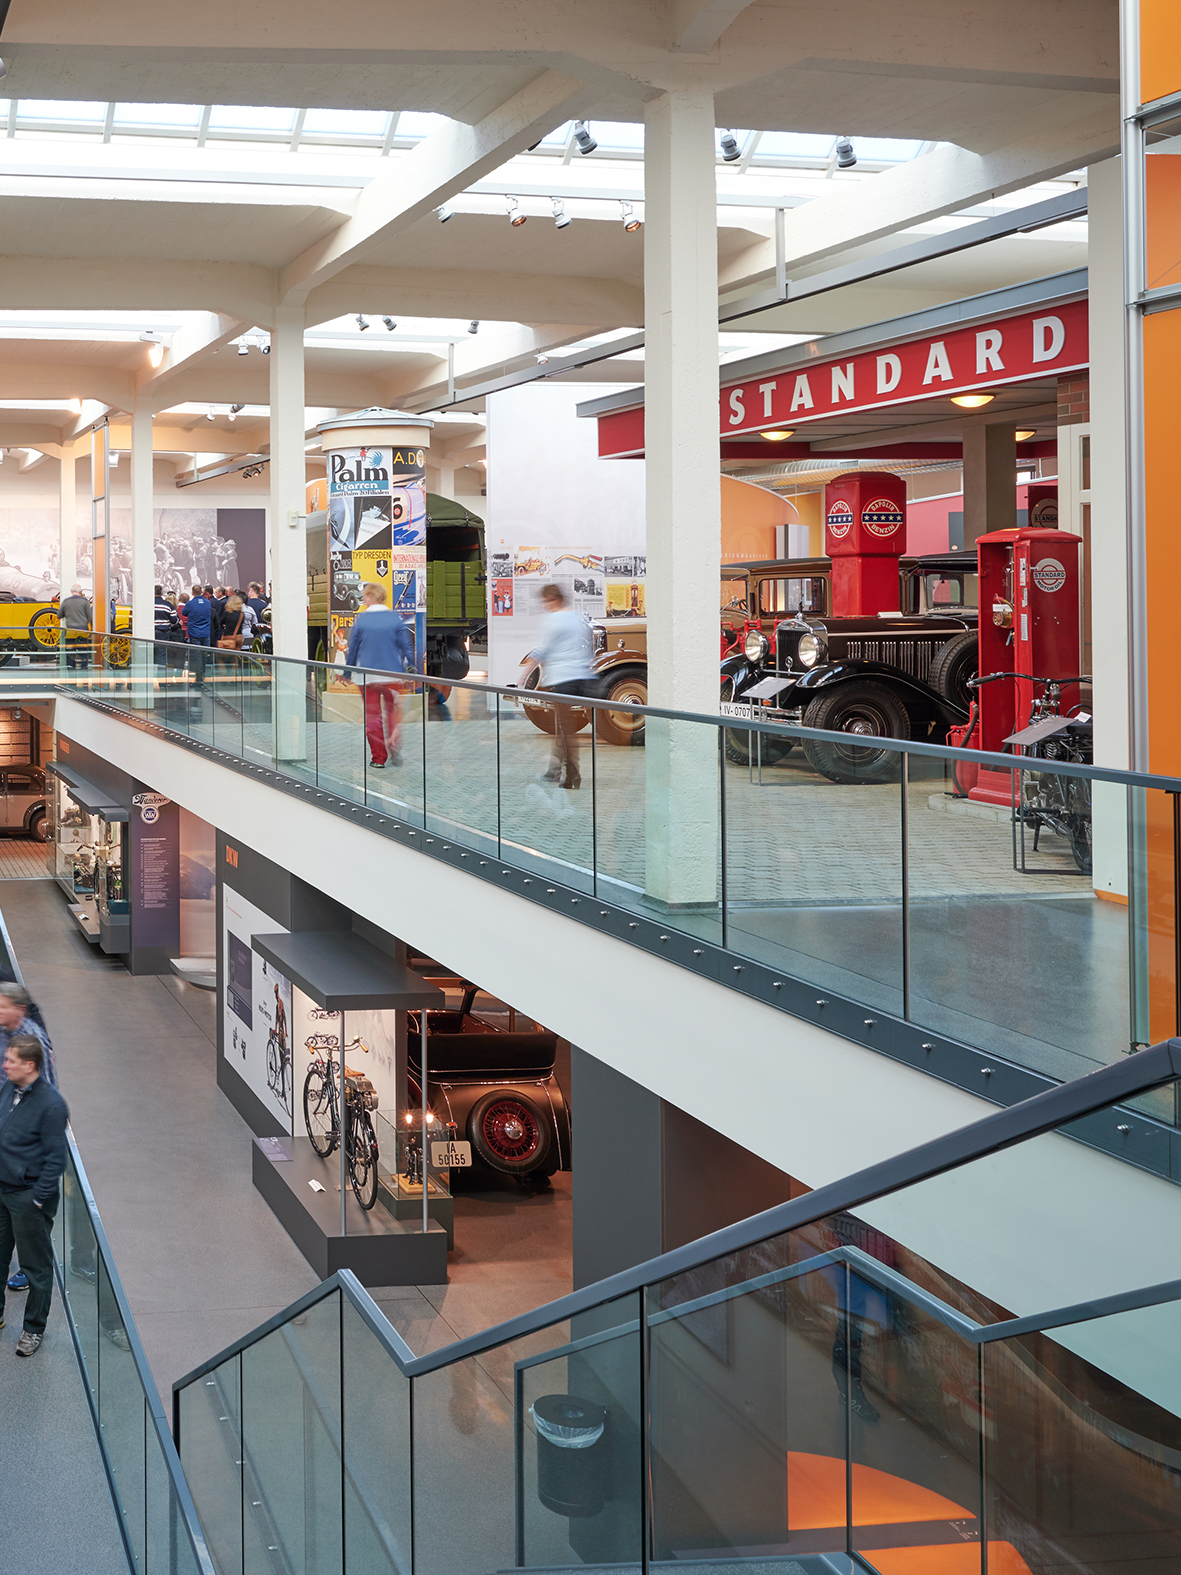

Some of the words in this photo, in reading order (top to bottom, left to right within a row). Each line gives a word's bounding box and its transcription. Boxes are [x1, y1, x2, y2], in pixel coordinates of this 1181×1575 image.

[728, 315, 1066, 425] STANDARD
[331, 454, 389, 484] Palm
[335, 482, 379, 491] Cigarren
[870, 524, 895, 533] BENZIN
[352, 551, 363, 559] TYP
[364, 551, 392, 559] DRESDEN
[1036, 580, 1054, 592] MOTOR
[1053, 580, 1063, 590] OIL
[226, 844, 239, 868] DKW
[446, 1142, 457, 1154] IA
[438, 1153, 466, 1166] 50155
